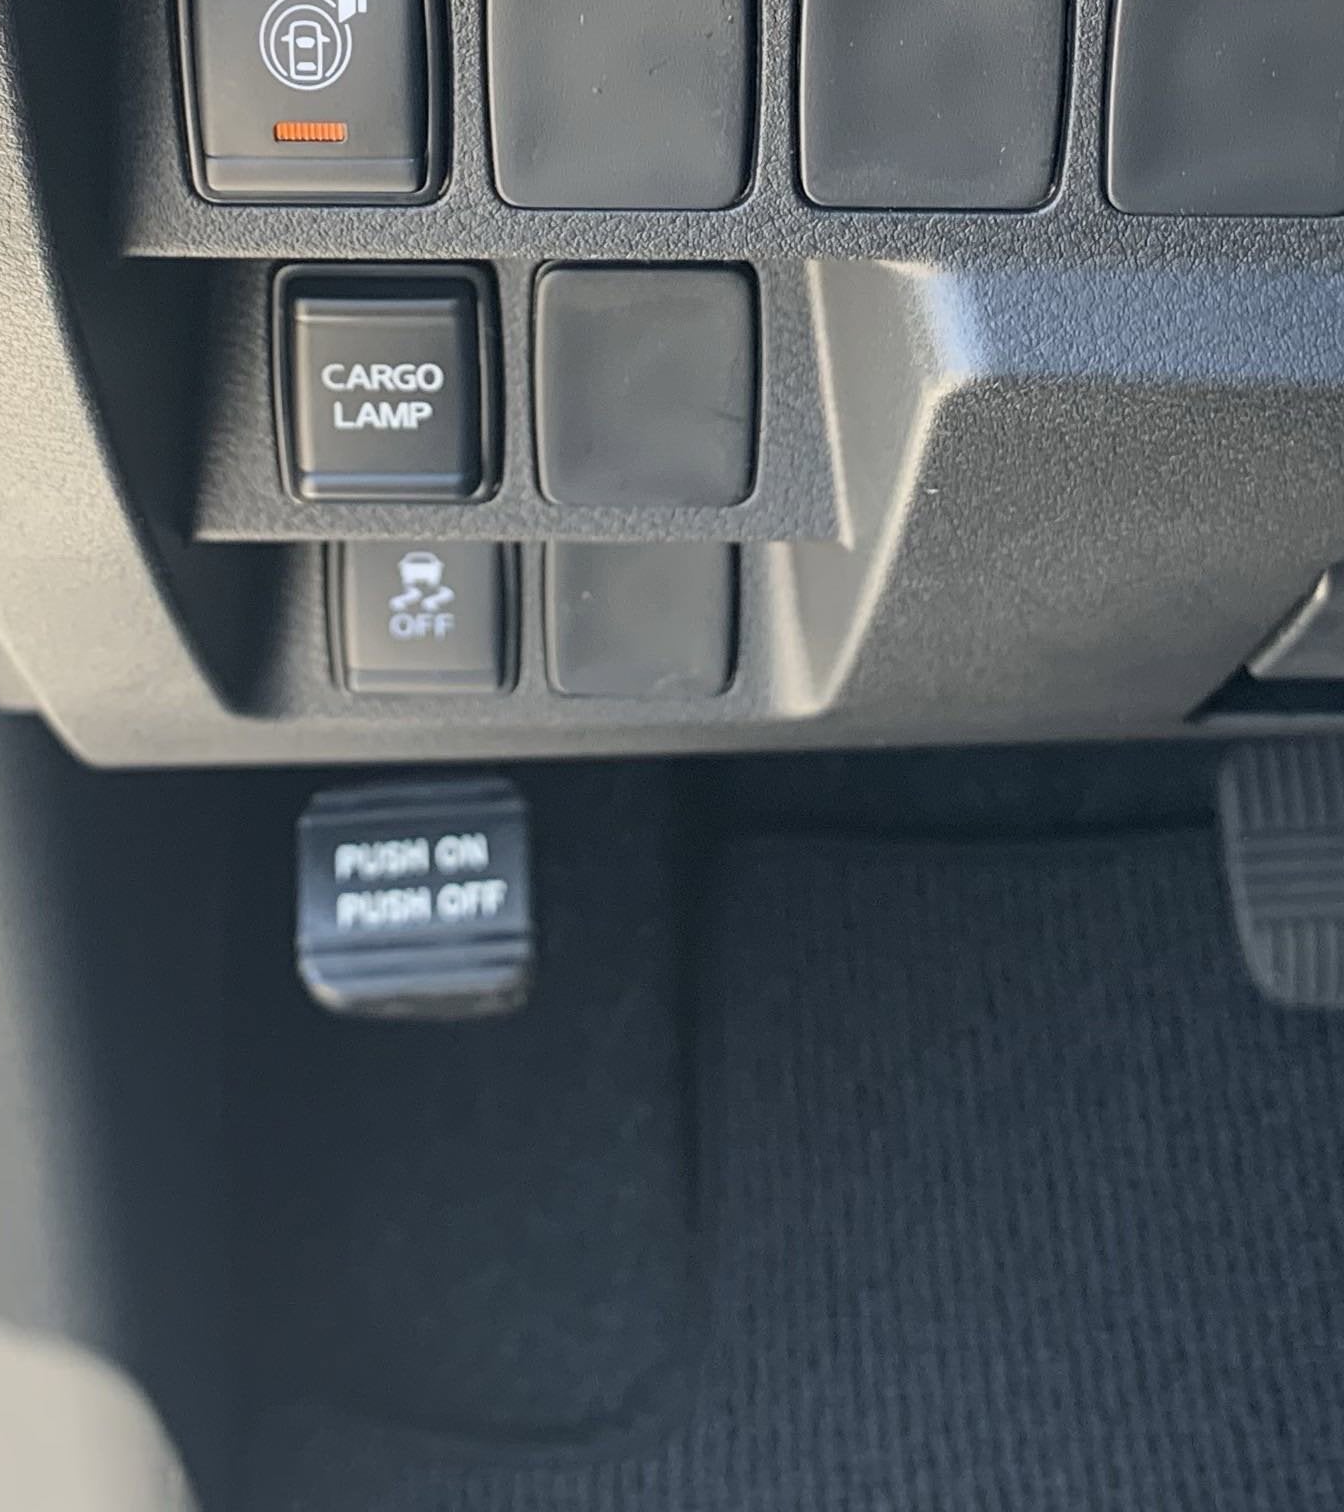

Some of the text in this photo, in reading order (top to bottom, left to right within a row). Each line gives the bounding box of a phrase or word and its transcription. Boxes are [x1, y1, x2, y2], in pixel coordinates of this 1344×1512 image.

[320, 362, 444, 391] CARGO
[333, 401, 432, 430] LAMP
[389, 613, 455, 638] OFF
[334, 833, 488, 881] PUSH ON
[336, 879, 508, 929] PUSH OFF
